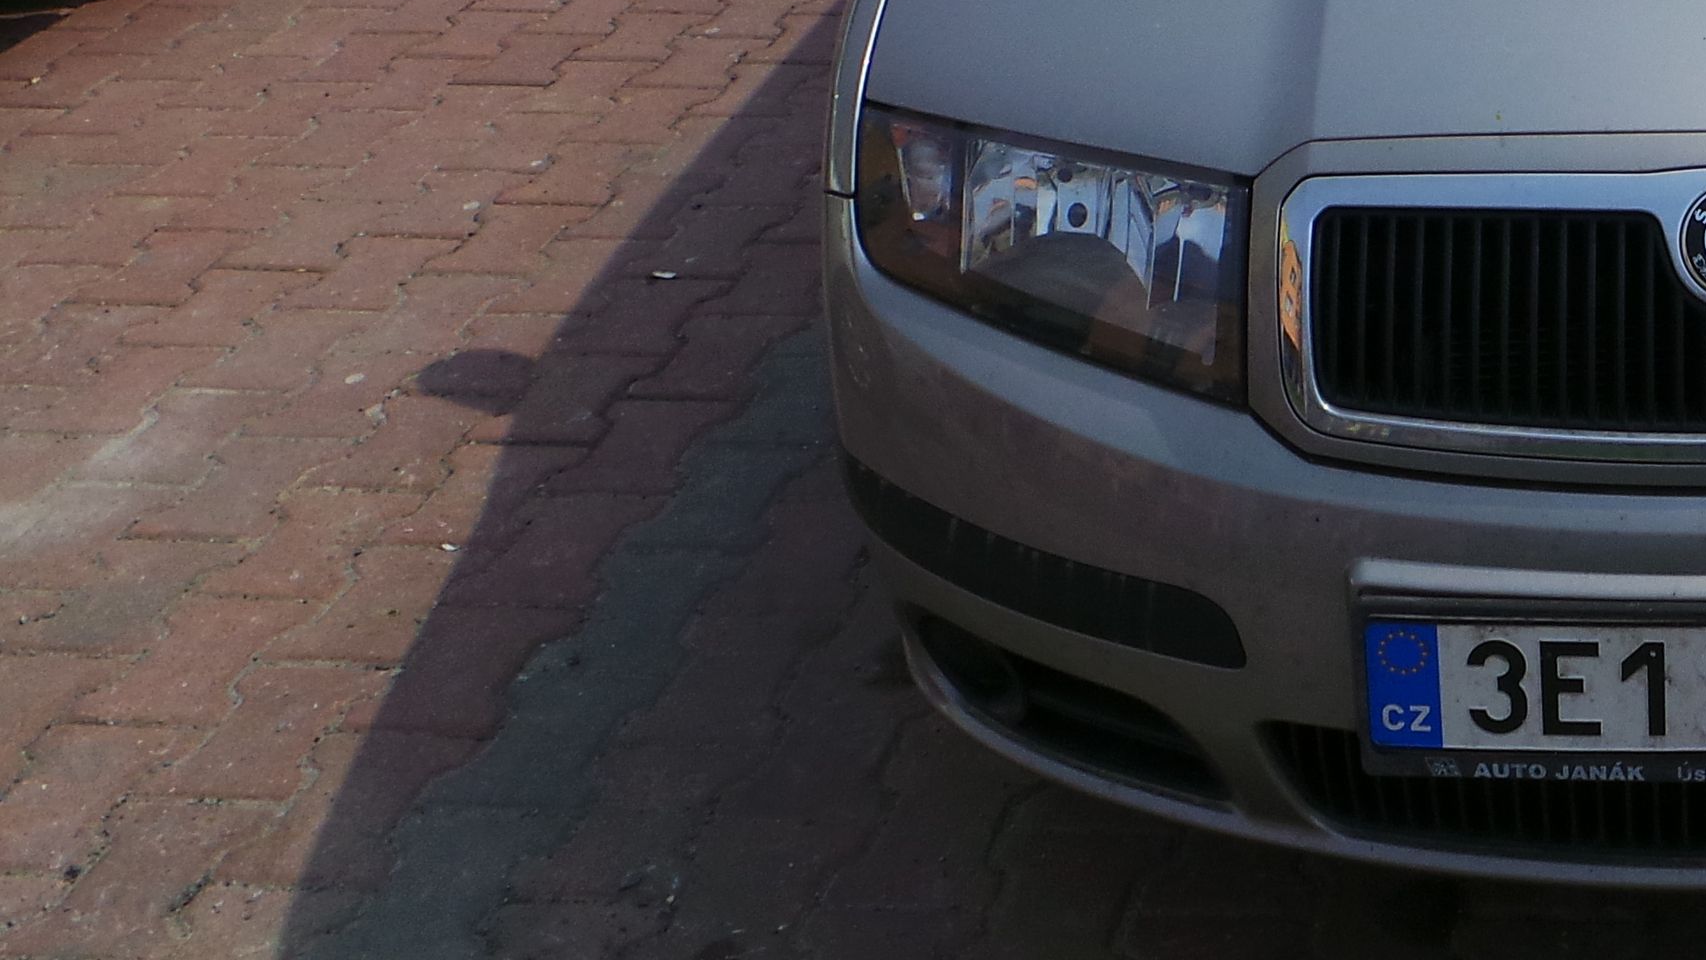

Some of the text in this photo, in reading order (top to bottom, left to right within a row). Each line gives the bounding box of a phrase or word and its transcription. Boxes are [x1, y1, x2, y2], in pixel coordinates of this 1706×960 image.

[1466, 639, 1666, 736] 3E1
[1381, 703, 1432, 733] CZ
[1473, 762, 1547, 779] AUTO
[1555, 760, 1645, 782] JANÁK
